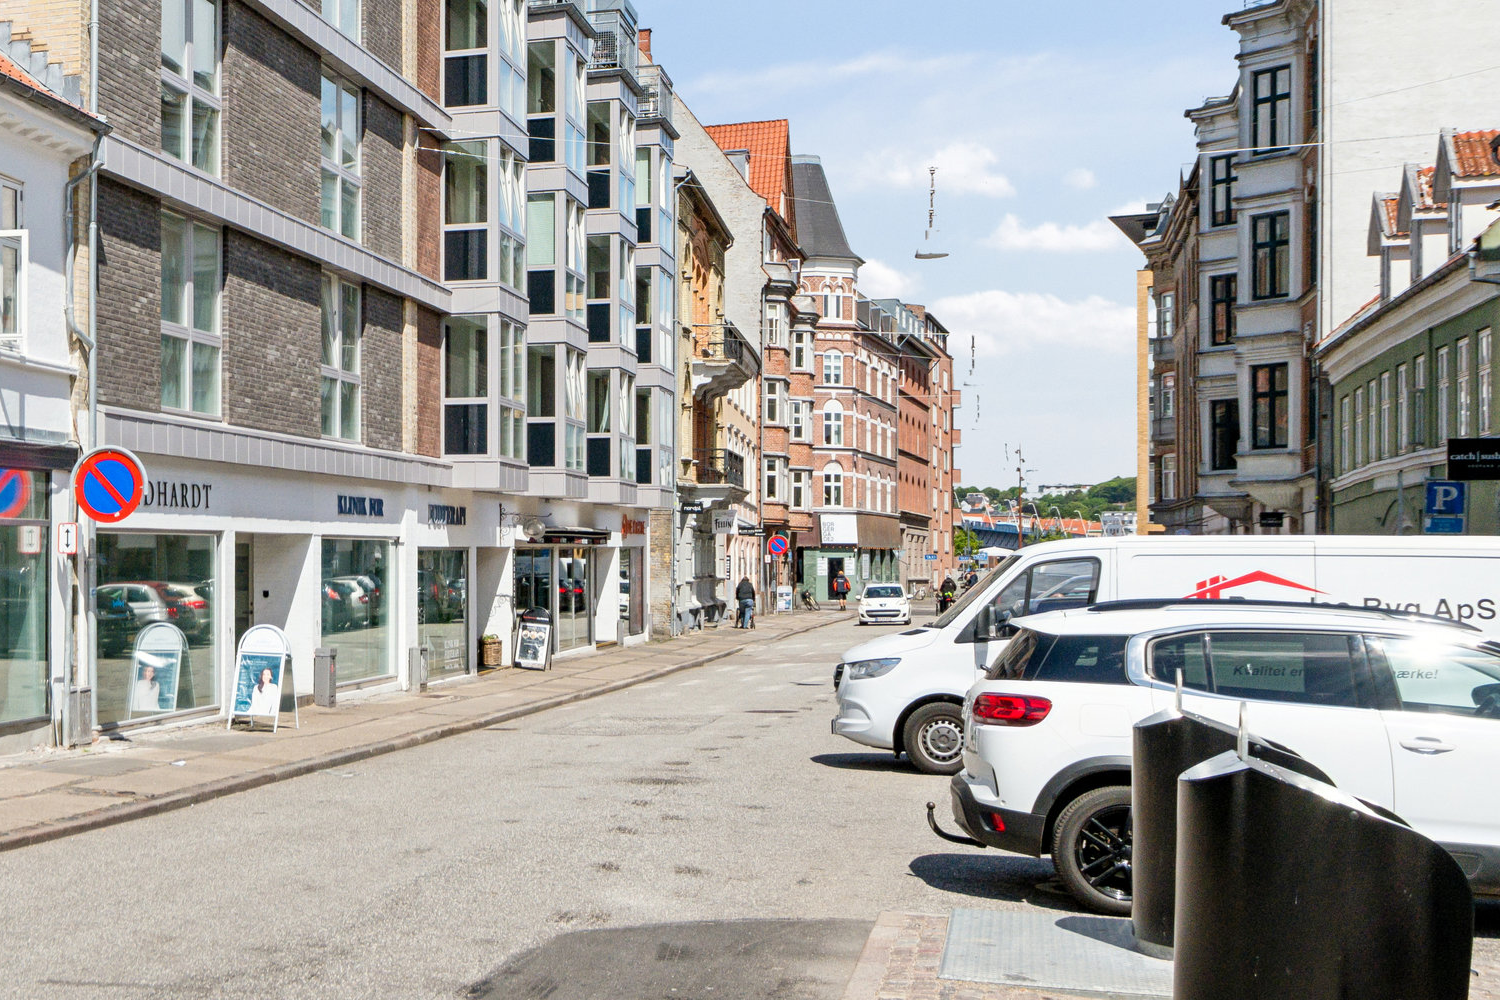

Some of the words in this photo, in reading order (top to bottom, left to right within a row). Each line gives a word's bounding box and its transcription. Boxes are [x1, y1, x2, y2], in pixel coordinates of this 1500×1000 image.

[1450, 451, 1476, 460] catch
[139, 480, 212, 509] DHARDT
[337, 494, 367, 515] KLINIK
[369, 497, 384, 517] FOR
[1432, 486, 1458, 510] P
[1434, 598, 1497, 622] ApS
[1393, 669, 1439, 680] ærke!
